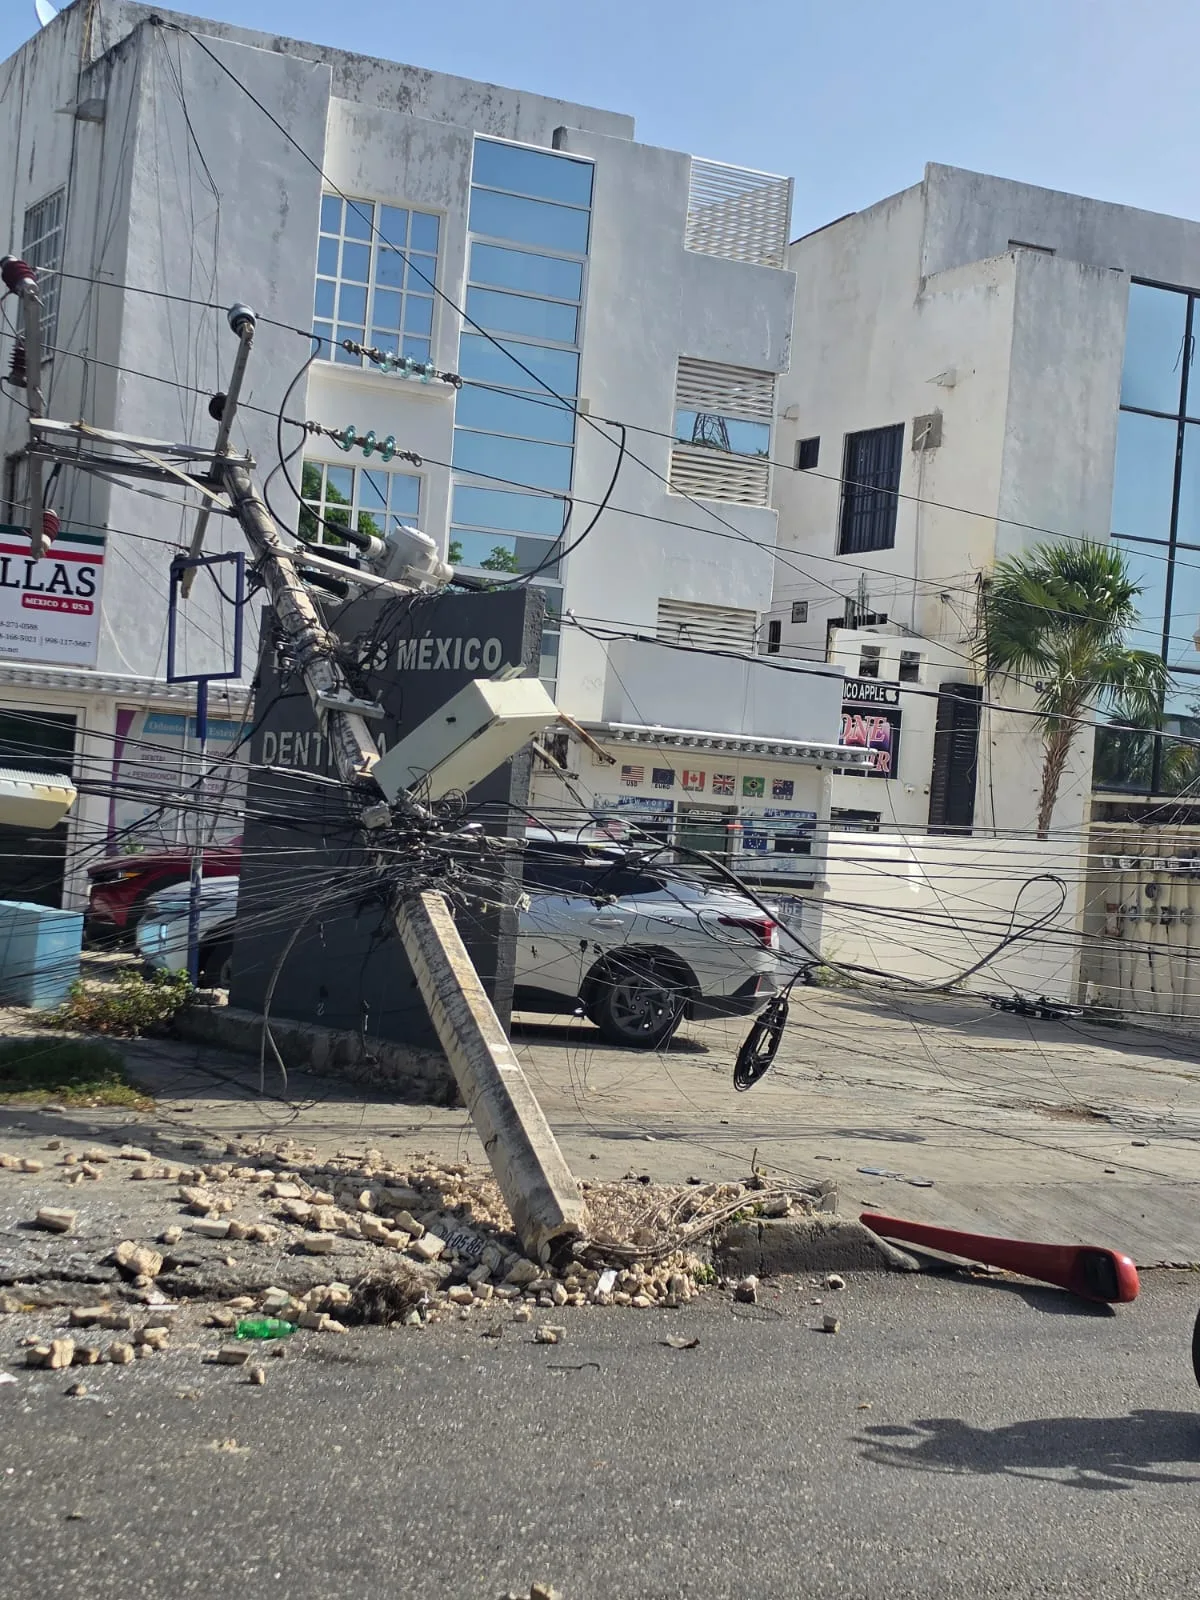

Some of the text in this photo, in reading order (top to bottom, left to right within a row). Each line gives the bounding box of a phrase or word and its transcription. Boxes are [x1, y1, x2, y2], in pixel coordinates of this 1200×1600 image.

[0, 556, 96, 598] LLAS
[25, 597, 59, 608] MEXICO
[72, 603, 90, 611] USA
[397, 630, 503, 671] MÉXICO
[859, 684, 885, 702] APPLE
